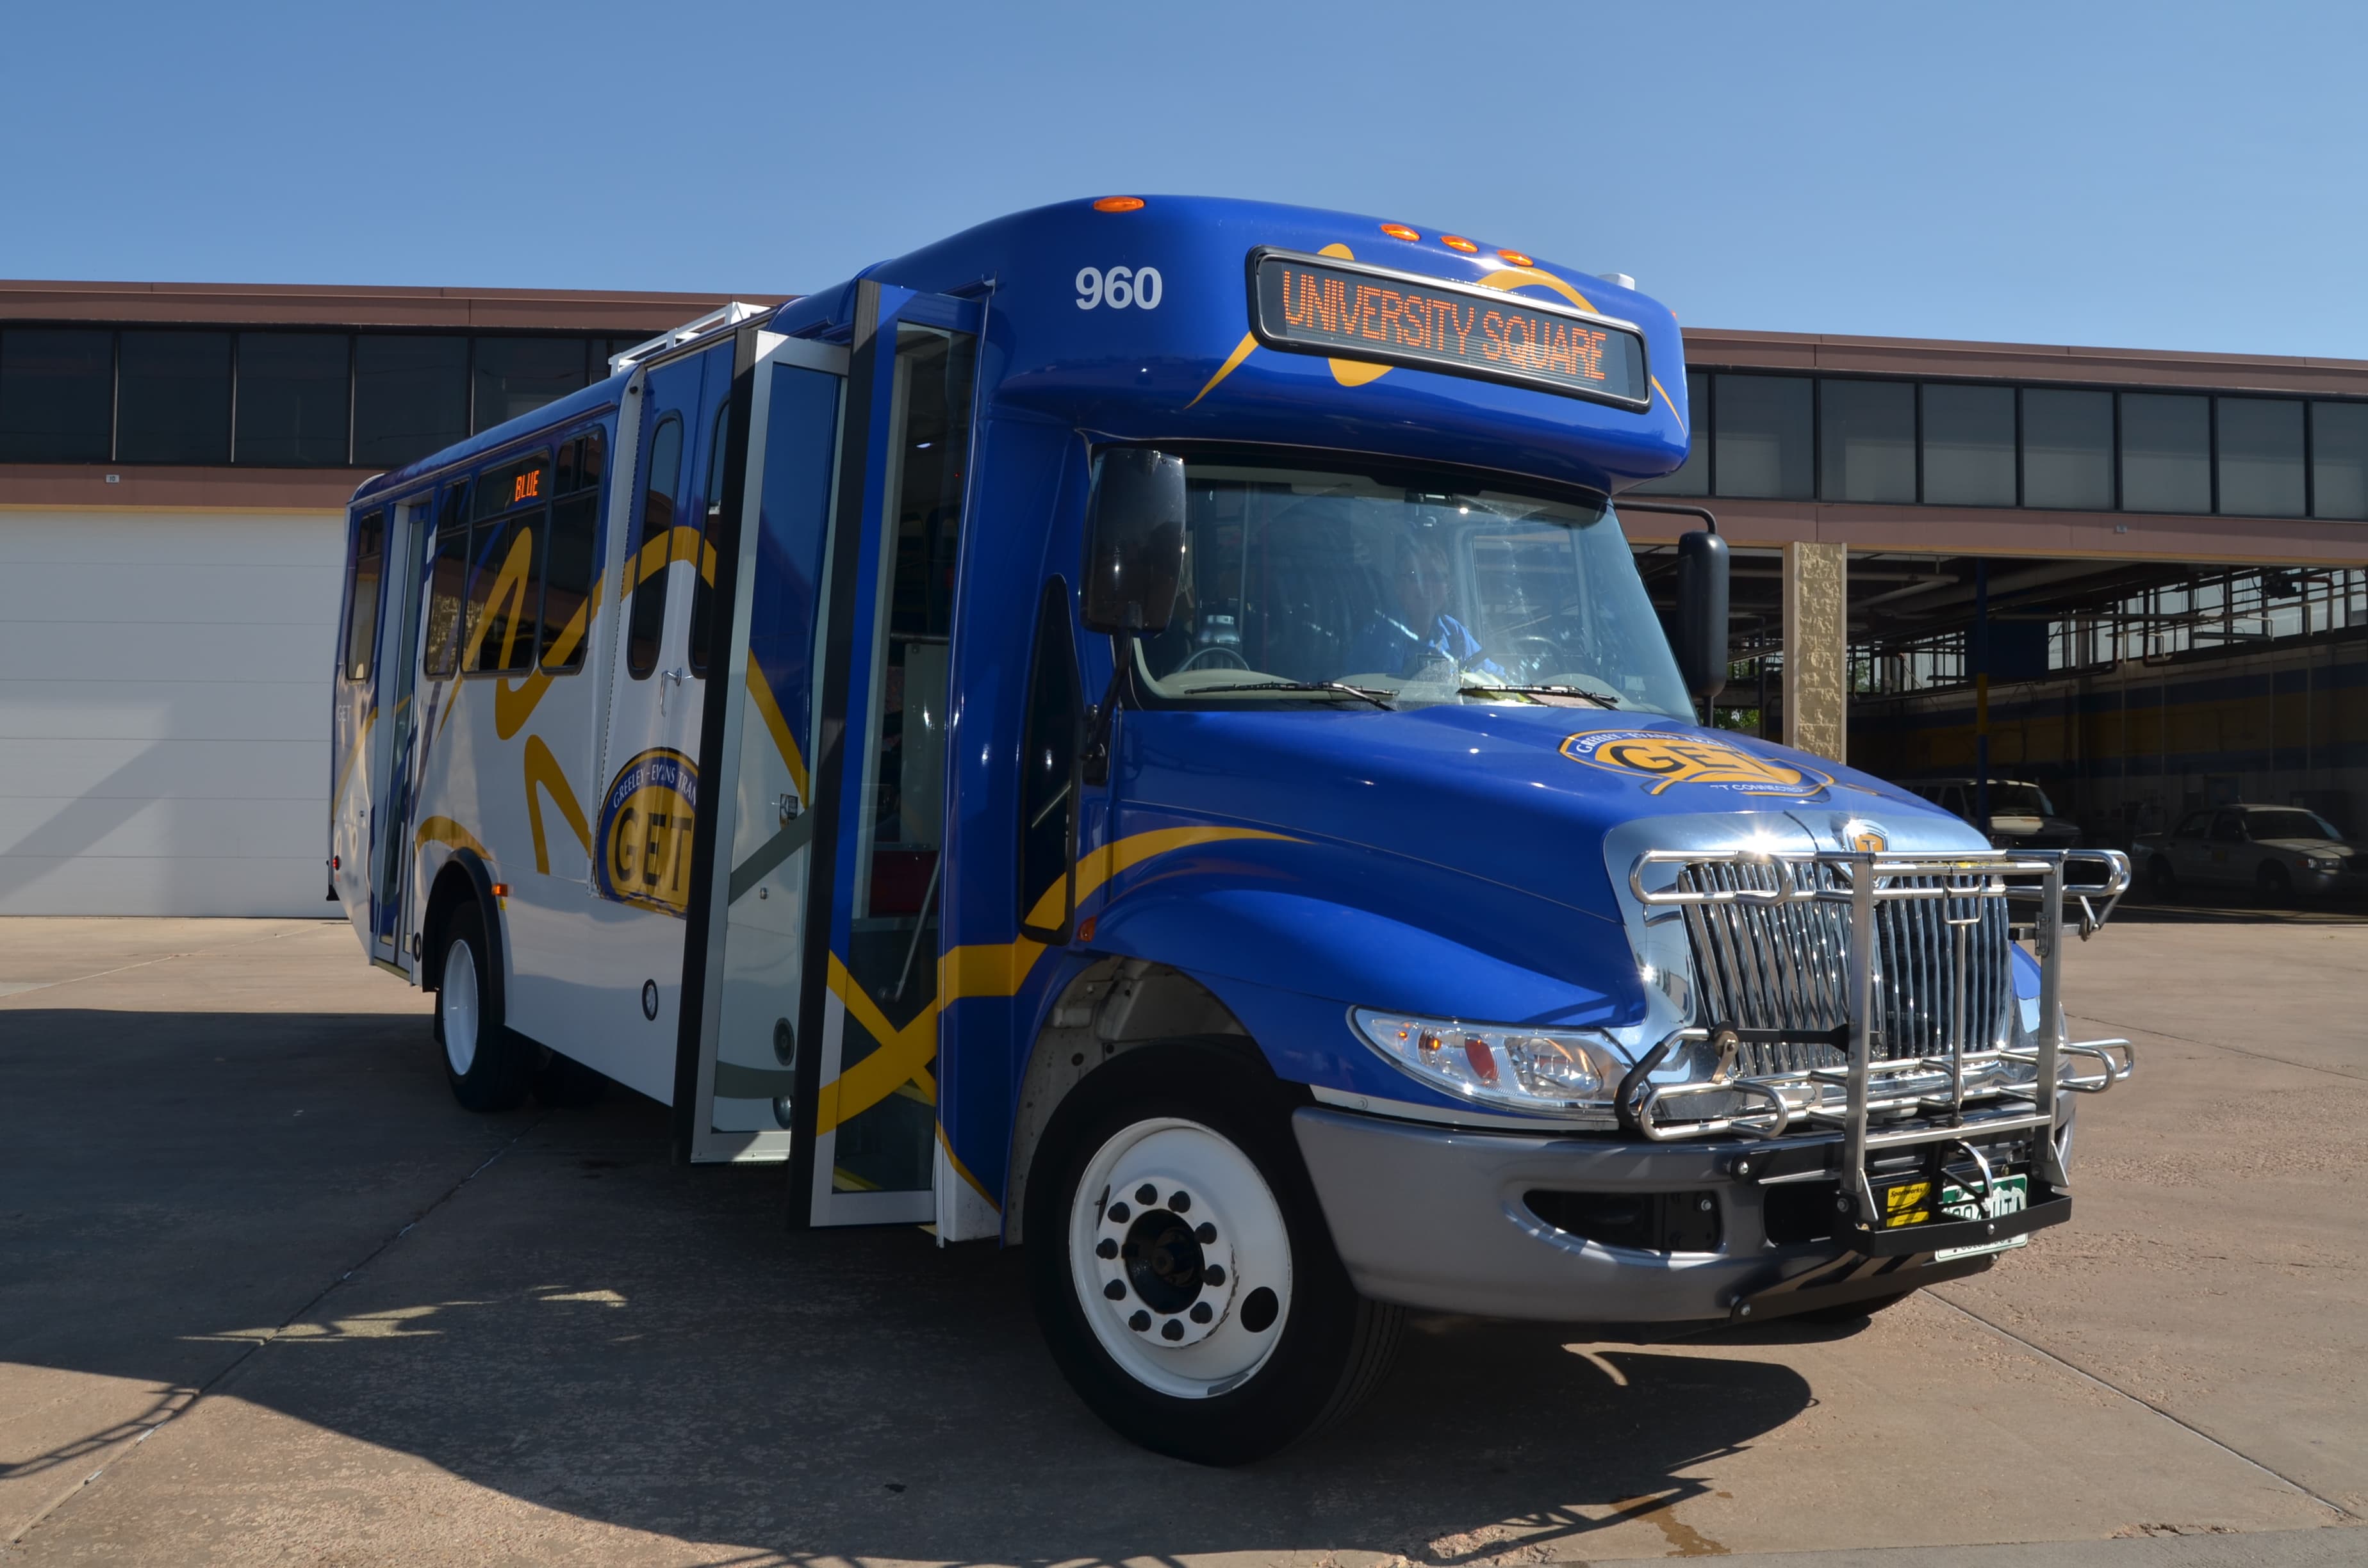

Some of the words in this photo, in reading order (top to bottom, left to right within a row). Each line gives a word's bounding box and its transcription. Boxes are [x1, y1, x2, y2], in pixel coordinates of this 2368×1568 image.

[1075, 266, 1162, 310] 960
[1283, 270, 1475, 356] UNIVERSITY
[1483, 310, 1607, 381] SQUARE
[514, 470, 540, 502] BLUE
[338, 705, 352, 722] GET
[614, 807, 693, 892] GET
